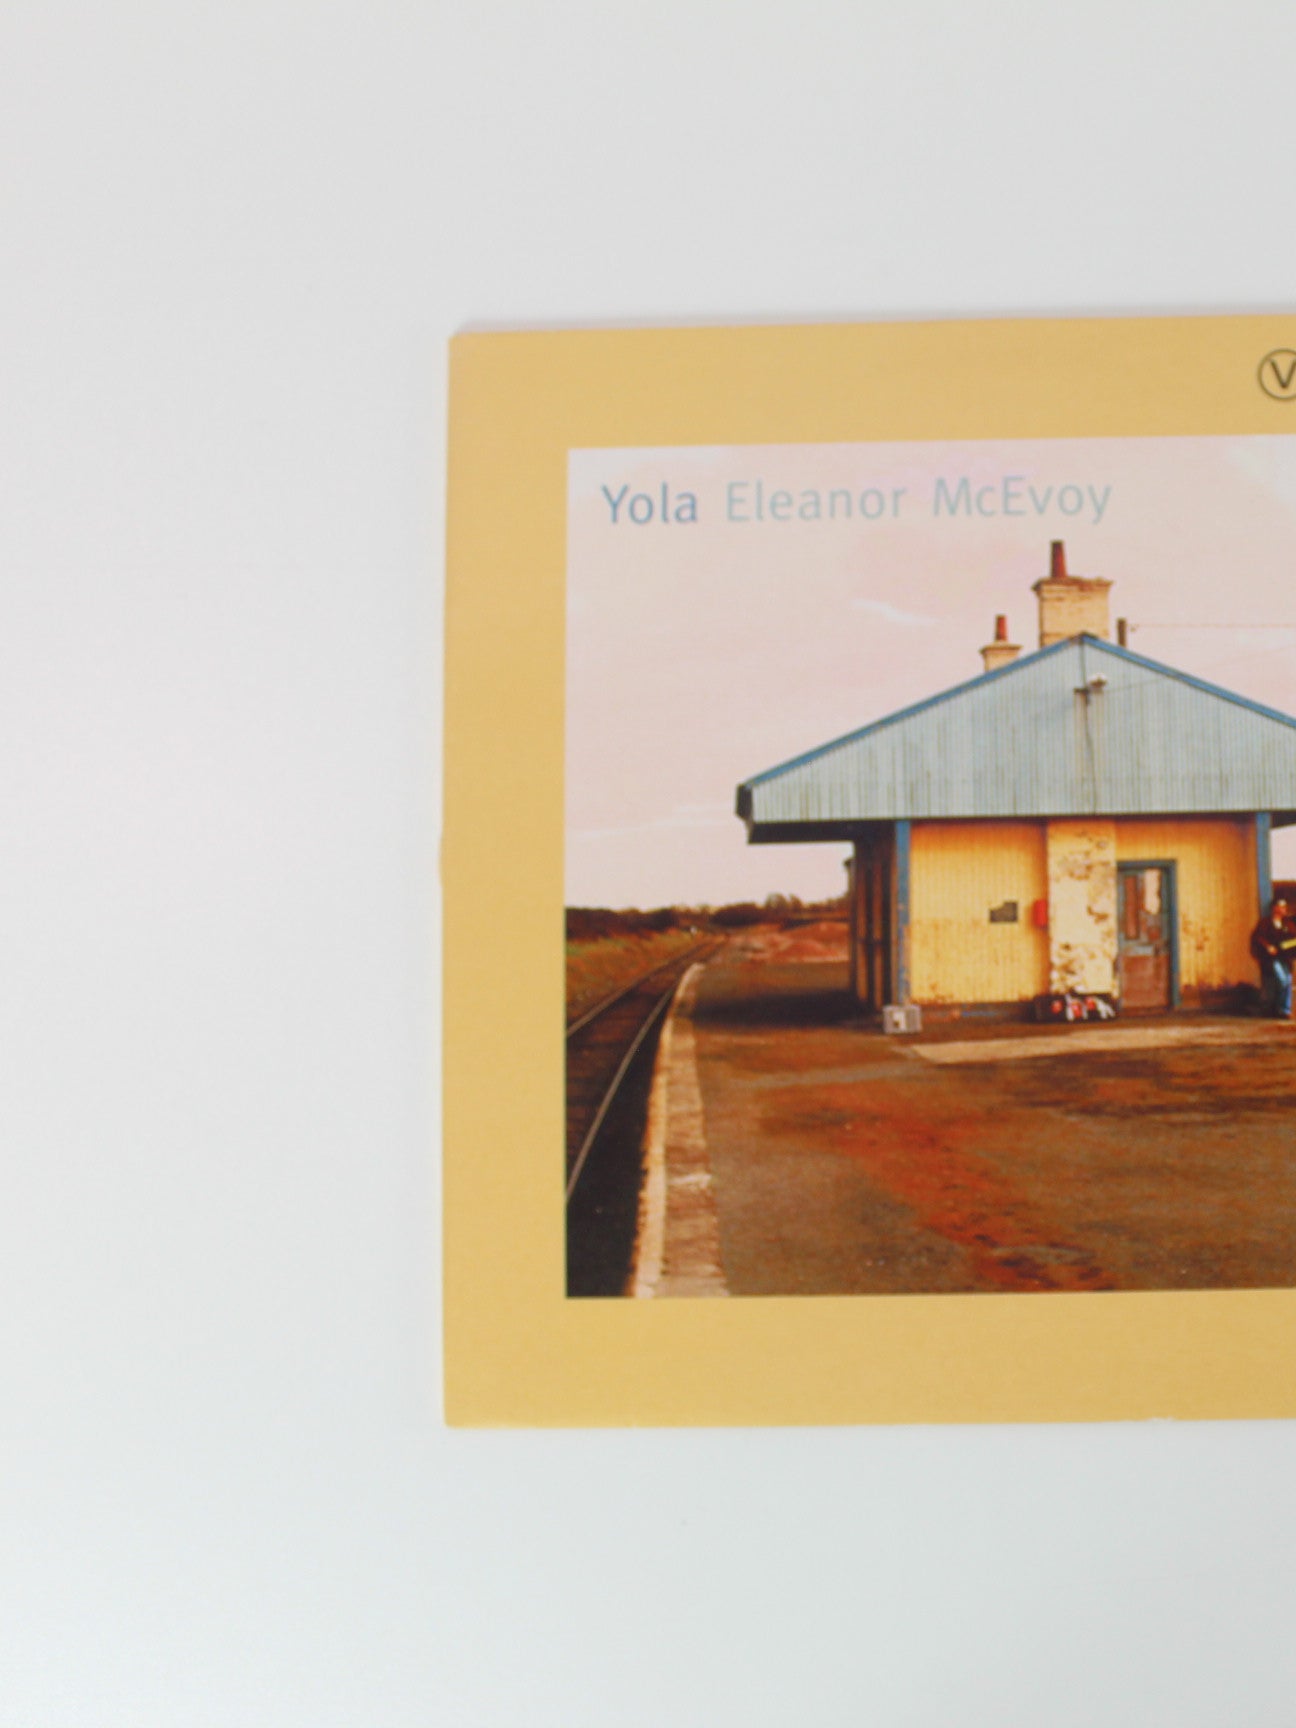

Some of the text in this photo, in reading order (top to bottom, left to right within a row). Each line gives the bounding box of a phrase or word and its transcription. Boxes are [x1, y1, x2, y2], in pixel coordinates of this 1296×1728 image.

[600, 476, 1113, 525] Yola Eleanor McEvoy
